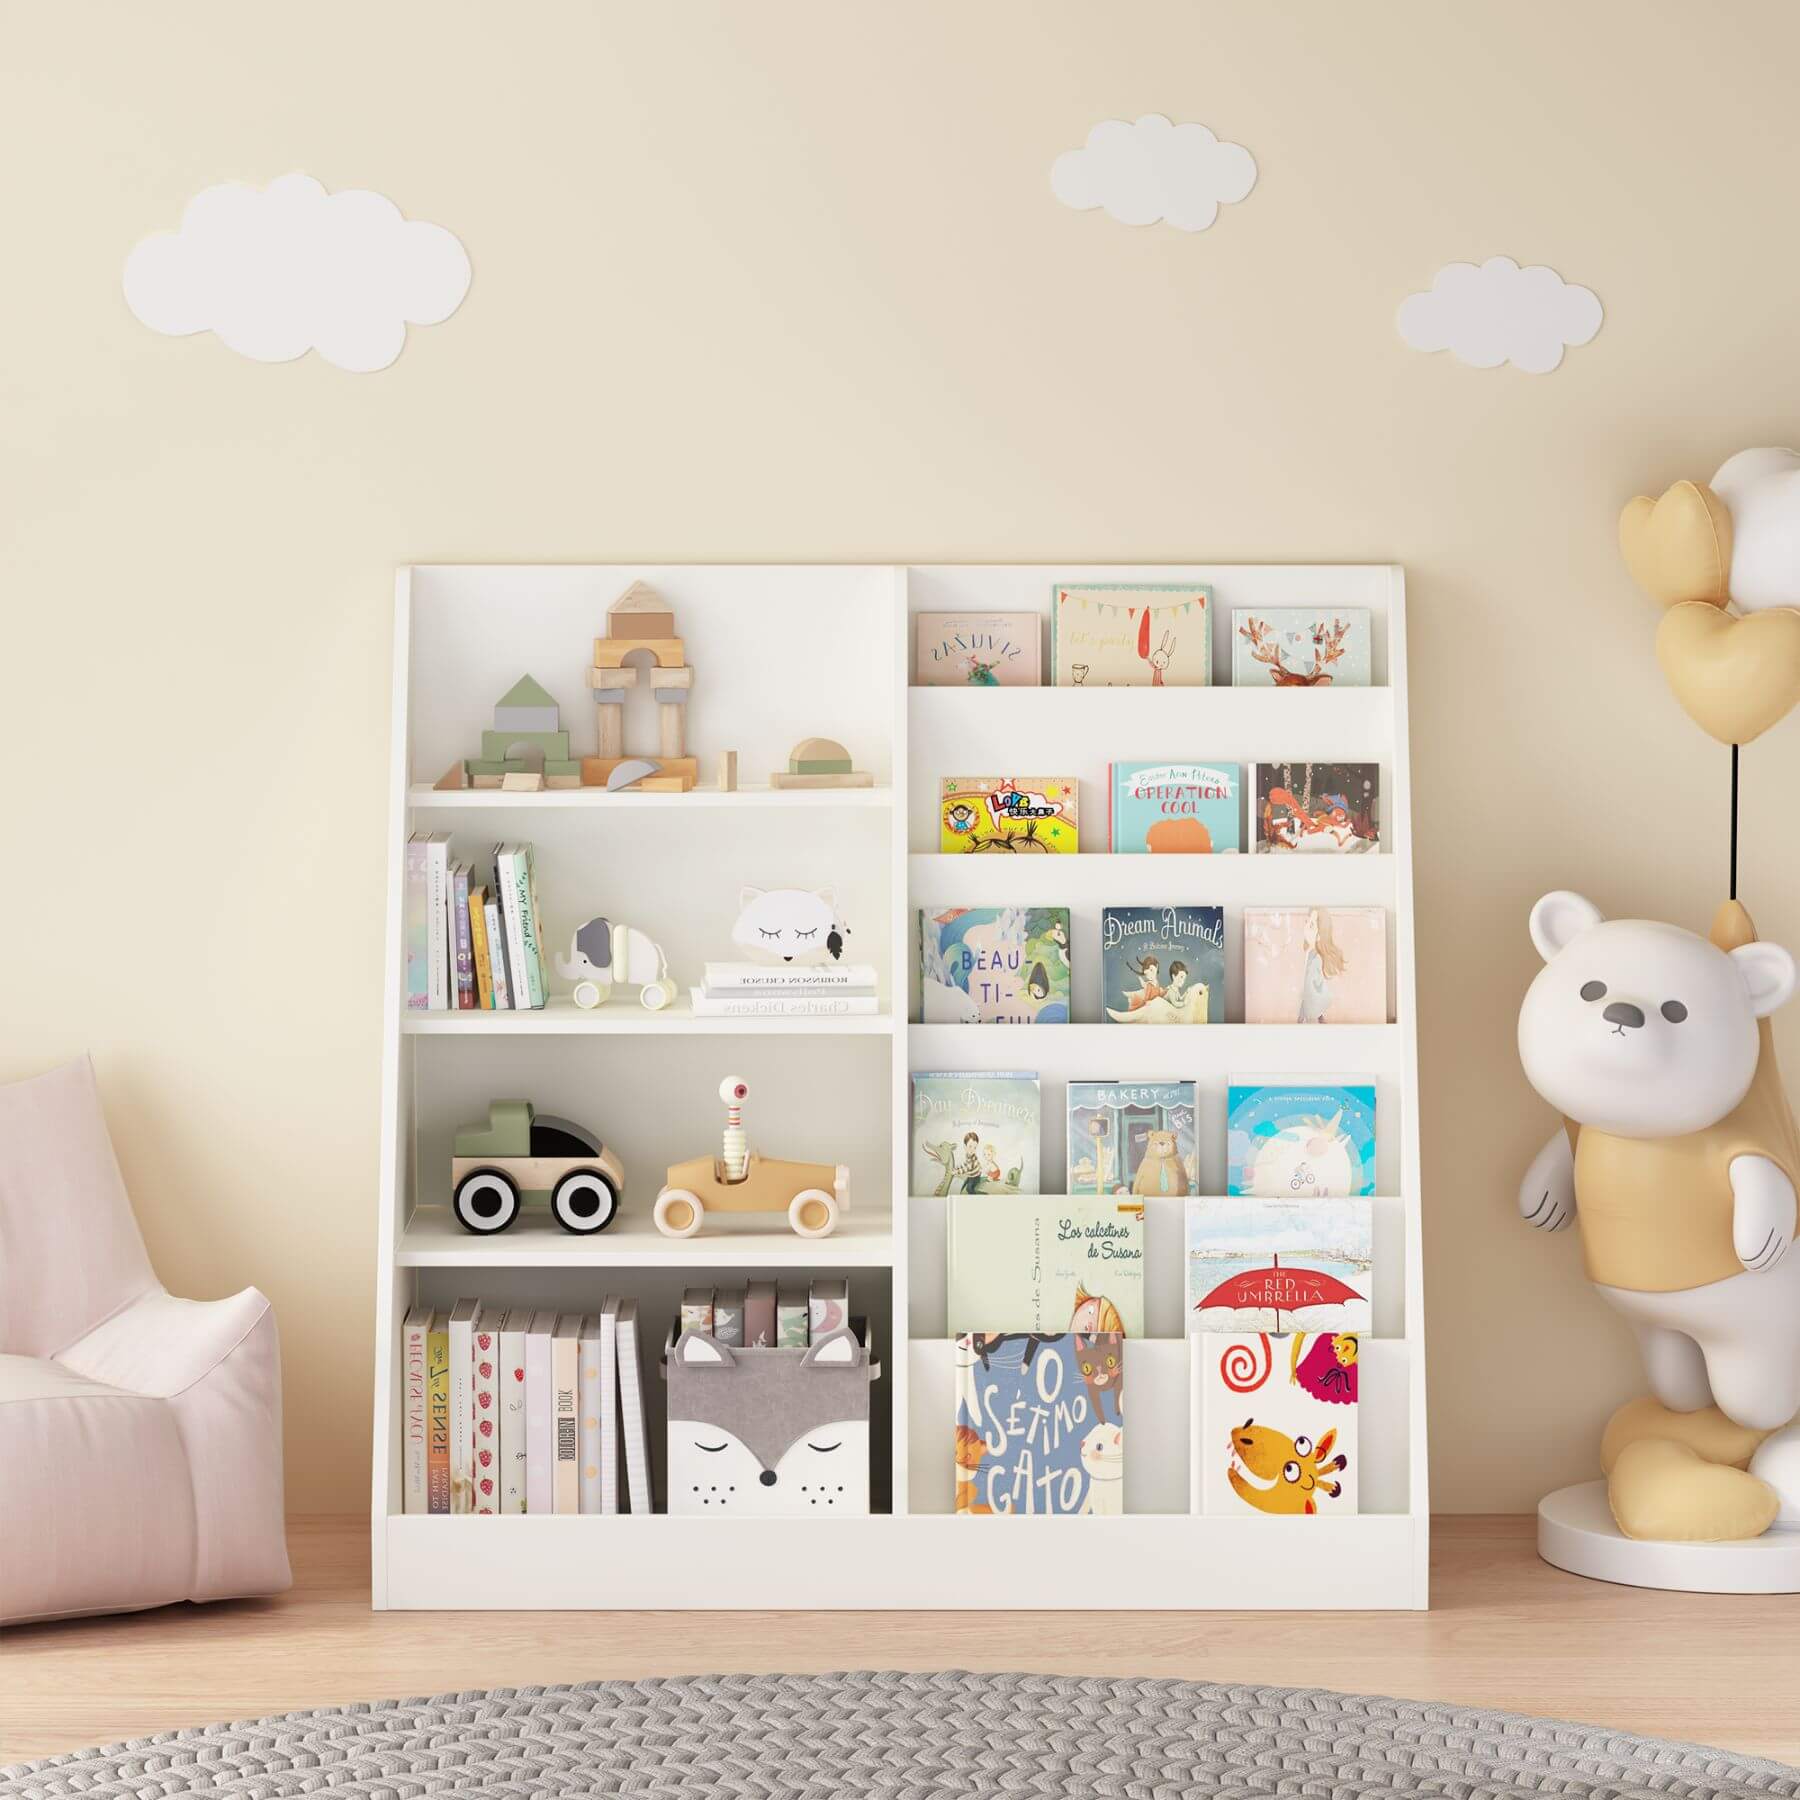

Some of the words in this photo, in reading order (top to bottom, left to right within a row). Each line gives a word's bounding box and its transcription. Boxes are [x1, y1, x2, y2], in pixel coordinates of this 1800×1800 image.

[1134, 786, 1228, 800] OPERATION
[1161, 800, 1200, 814] COOL
[1103, 912, 1158, 950] Dream
[1160, 905, 1223, 949] Animals
[1097, 1088, 1160, 1101] BAKERY
[1057, 1218, 1082, 1241] Los
[1085, 1220, 1130, 1239] calcetines
[1087, 1242, 1099, 1259] de
[1100, 1240, 1142, 1260] Susana
[1264, 1278, 1296, 1291] RED
[1237, 1289, 1324, 1305] UMBRELLA
[1036, 1348, 1064, 1404] O
[557, 1390, 573, 1412] BOOK
[987, 1449, 1083, 1514] GATO
